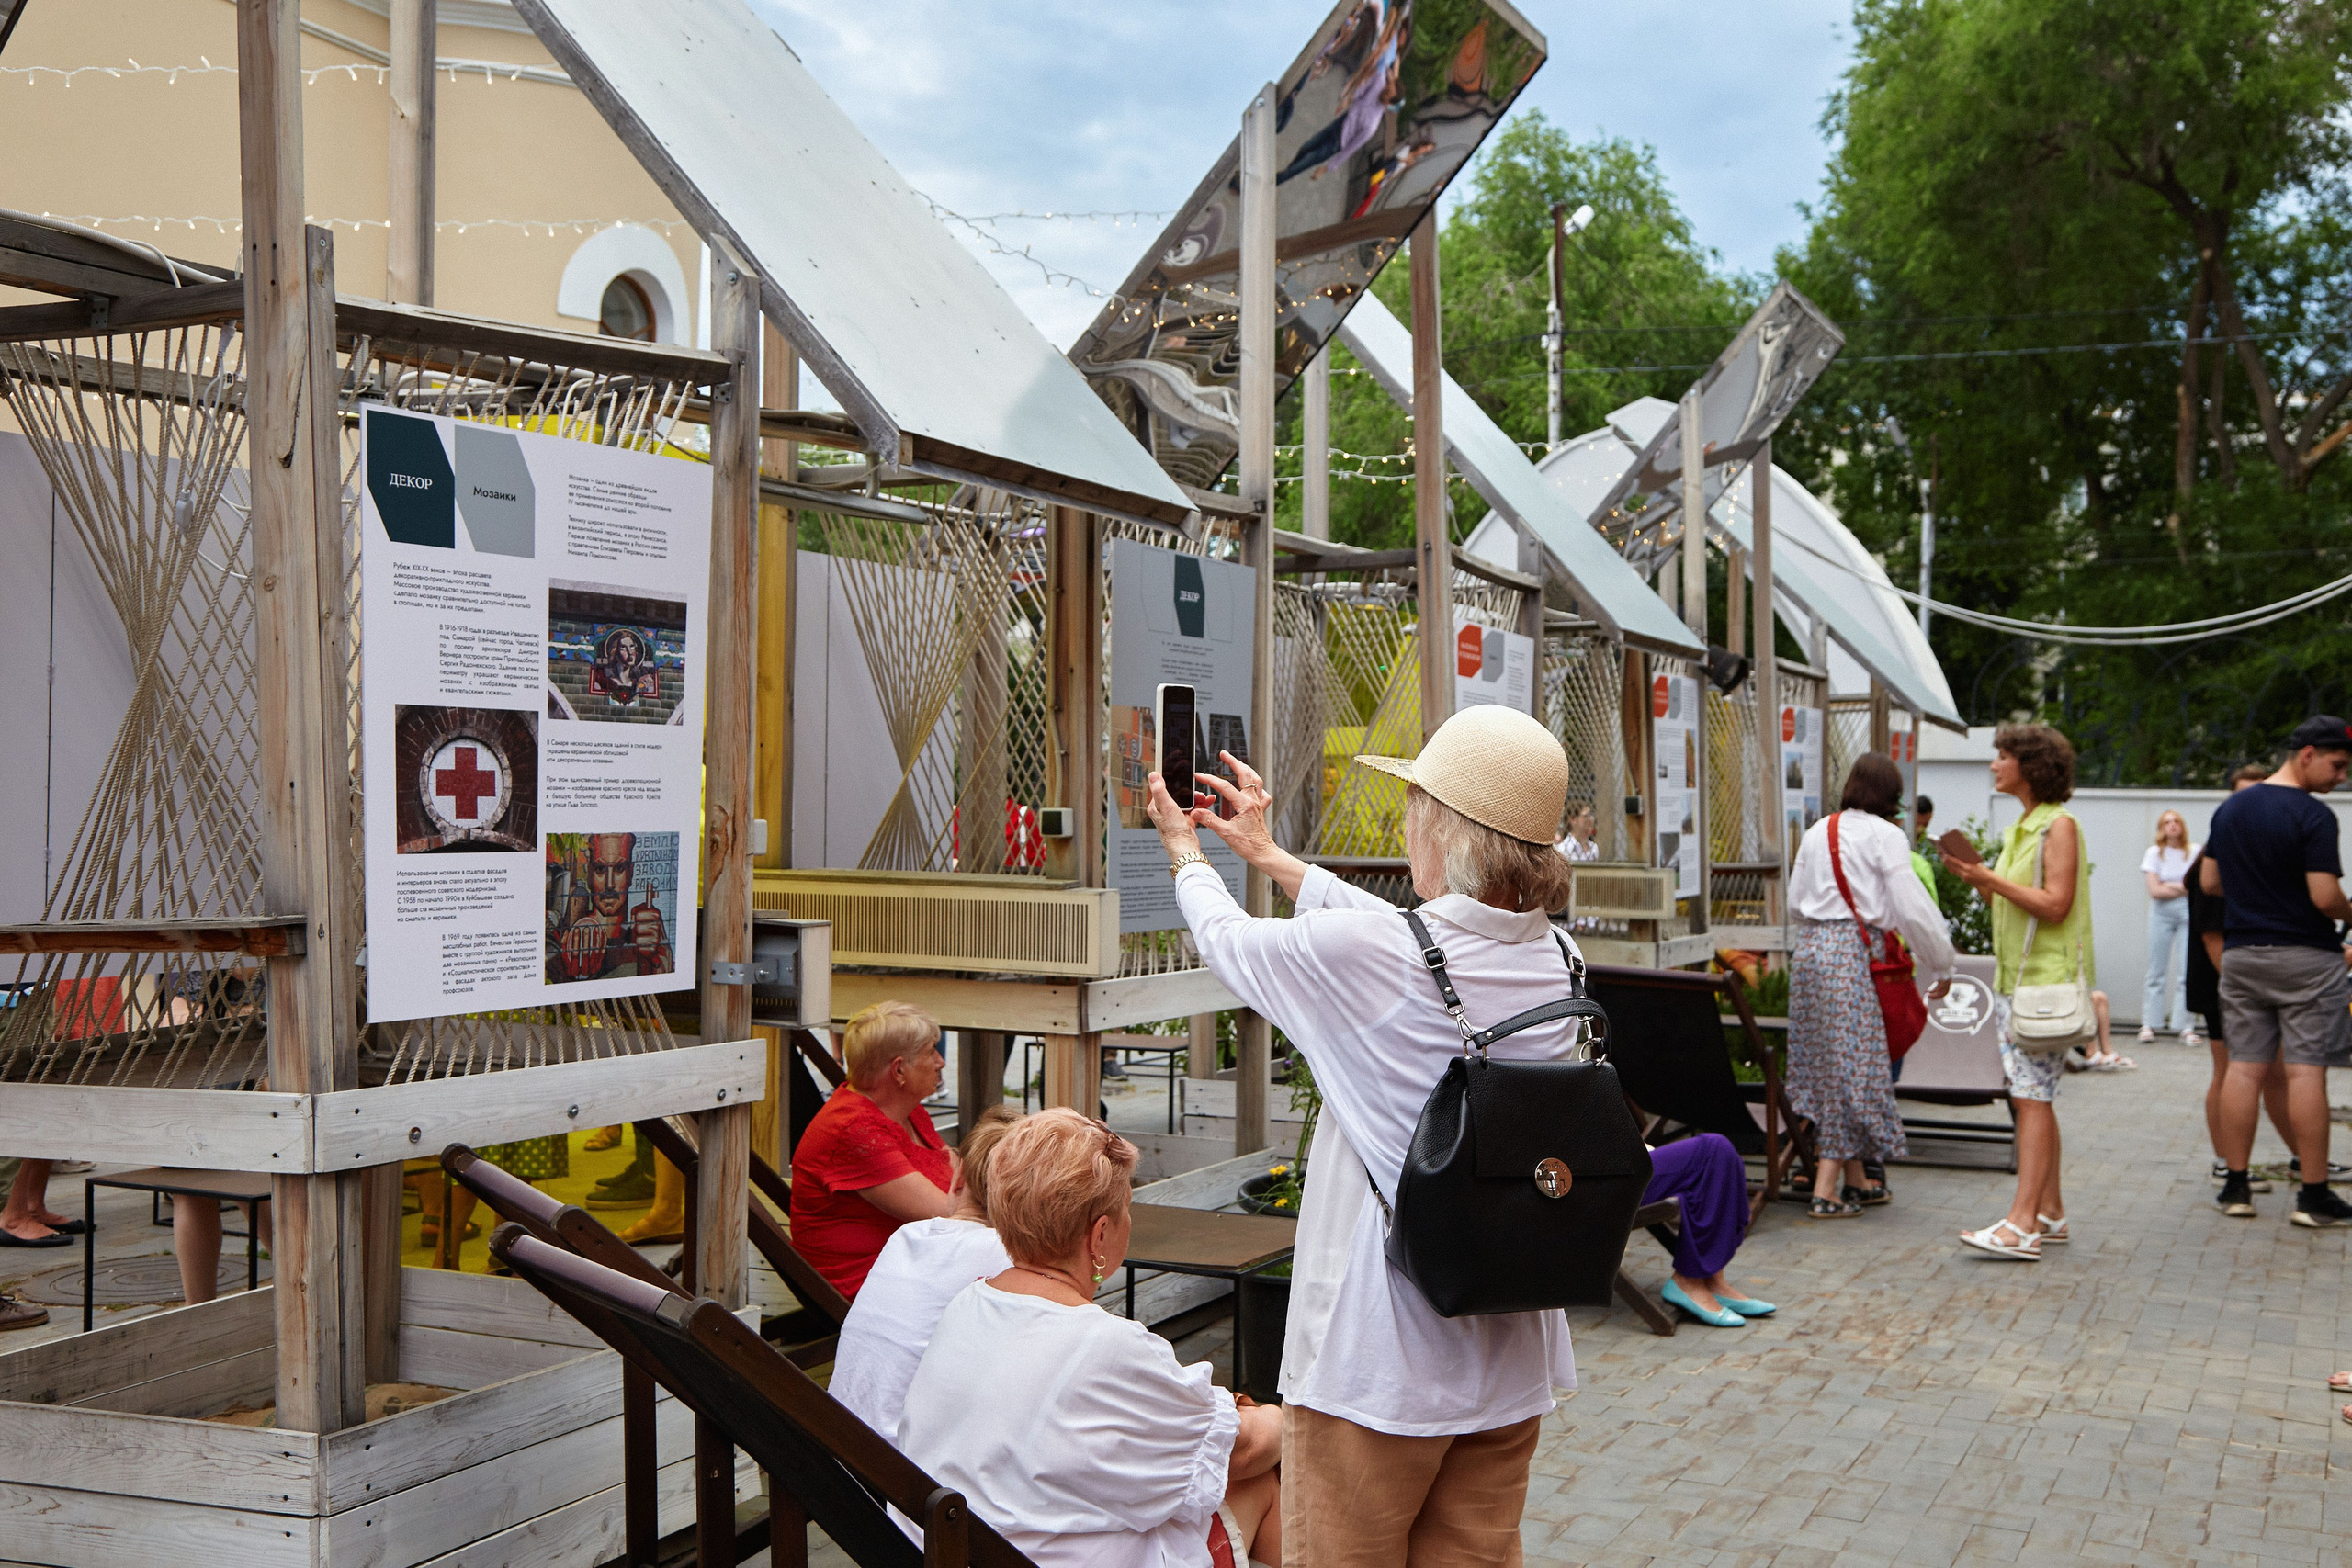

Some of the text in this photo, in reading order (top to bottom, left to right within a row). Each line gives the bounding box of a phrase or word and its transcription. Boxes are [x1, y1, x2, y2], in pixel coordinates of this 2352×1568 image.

[389, 473, 433, 490] ДЕКОР
[473, 486, 516, 502] Мозаики
[637, 835, 679, 848] ЗЕМЛЮ
